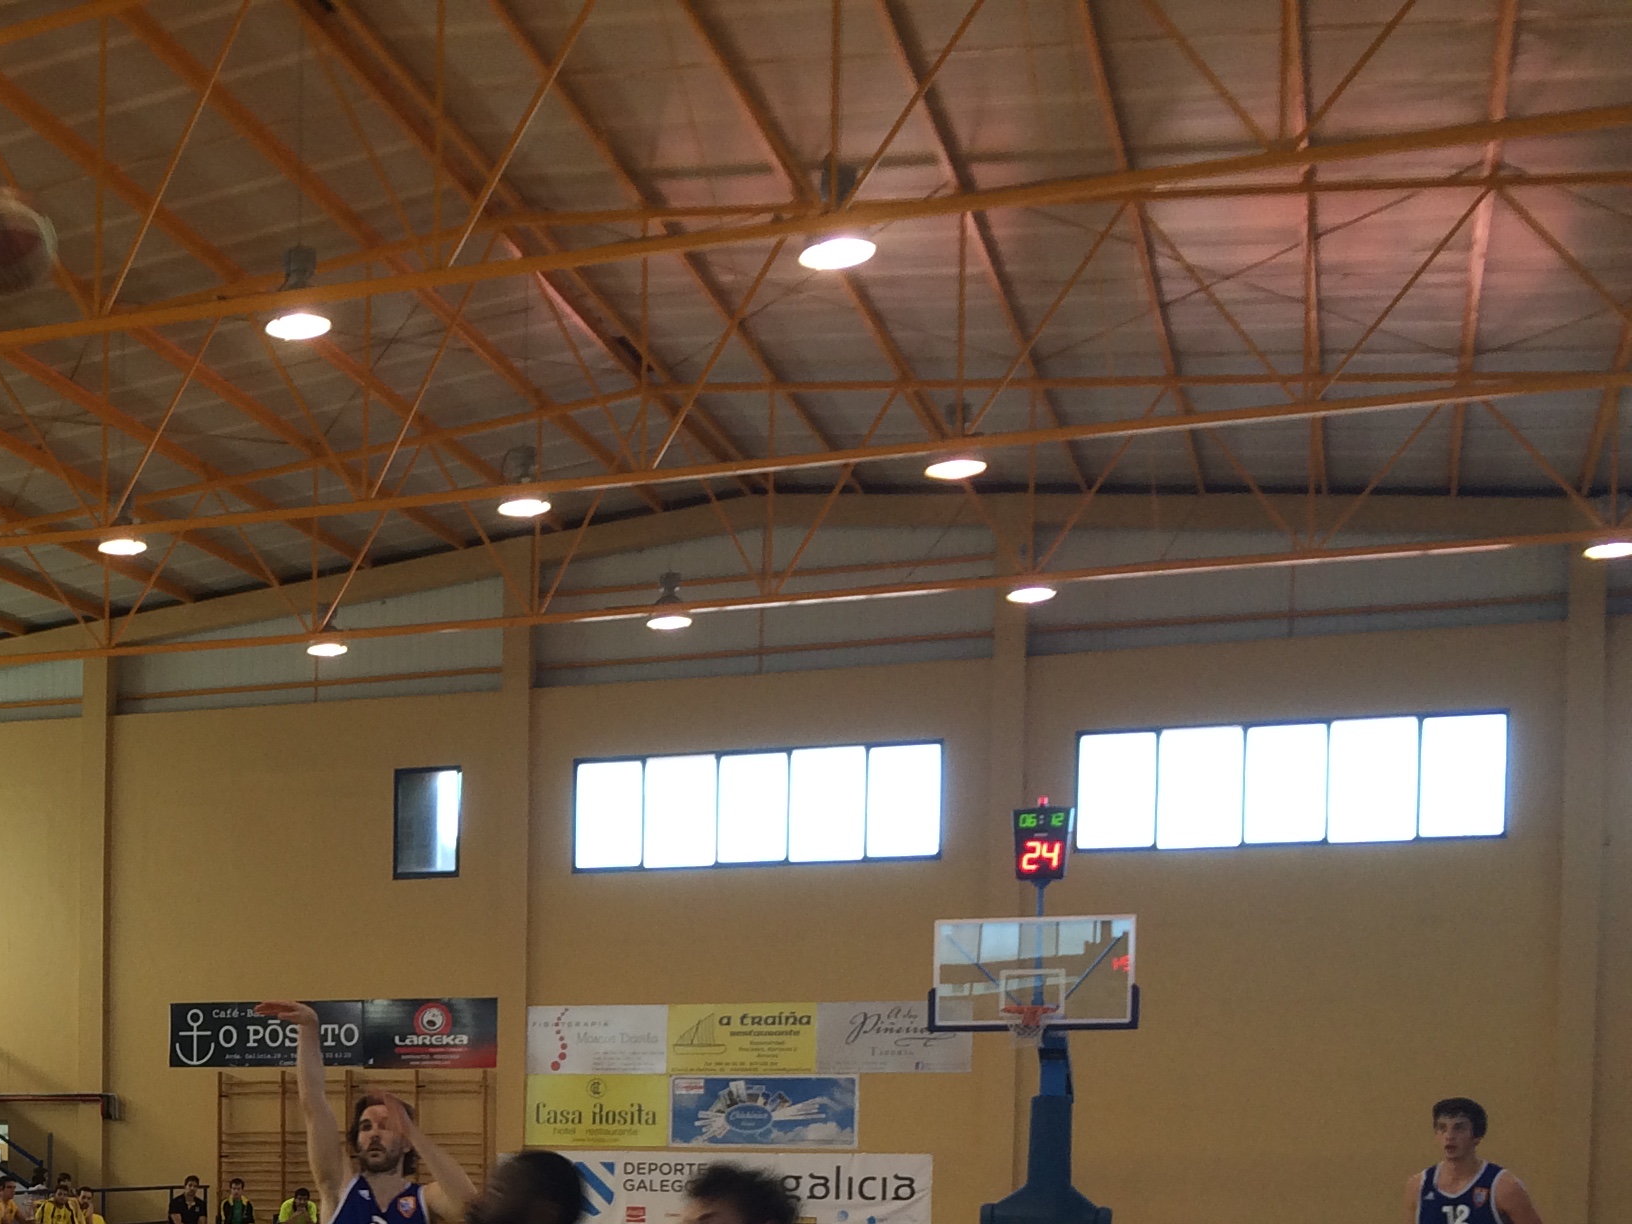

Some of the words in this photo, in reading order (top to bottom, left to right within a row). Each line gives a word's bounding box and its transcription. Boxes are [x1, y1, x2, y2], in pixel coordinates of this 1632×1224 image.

[1020, 840, 1063, 873] 24
[219, 1024, 237, 1048] O
[535, 1102, 582, 1126] Casa
[591, 1102, 657, 1126] Rosita
[623, 1161, 709, 1176] DEPORTE
[782, 1165, 917, 1202] galicia
